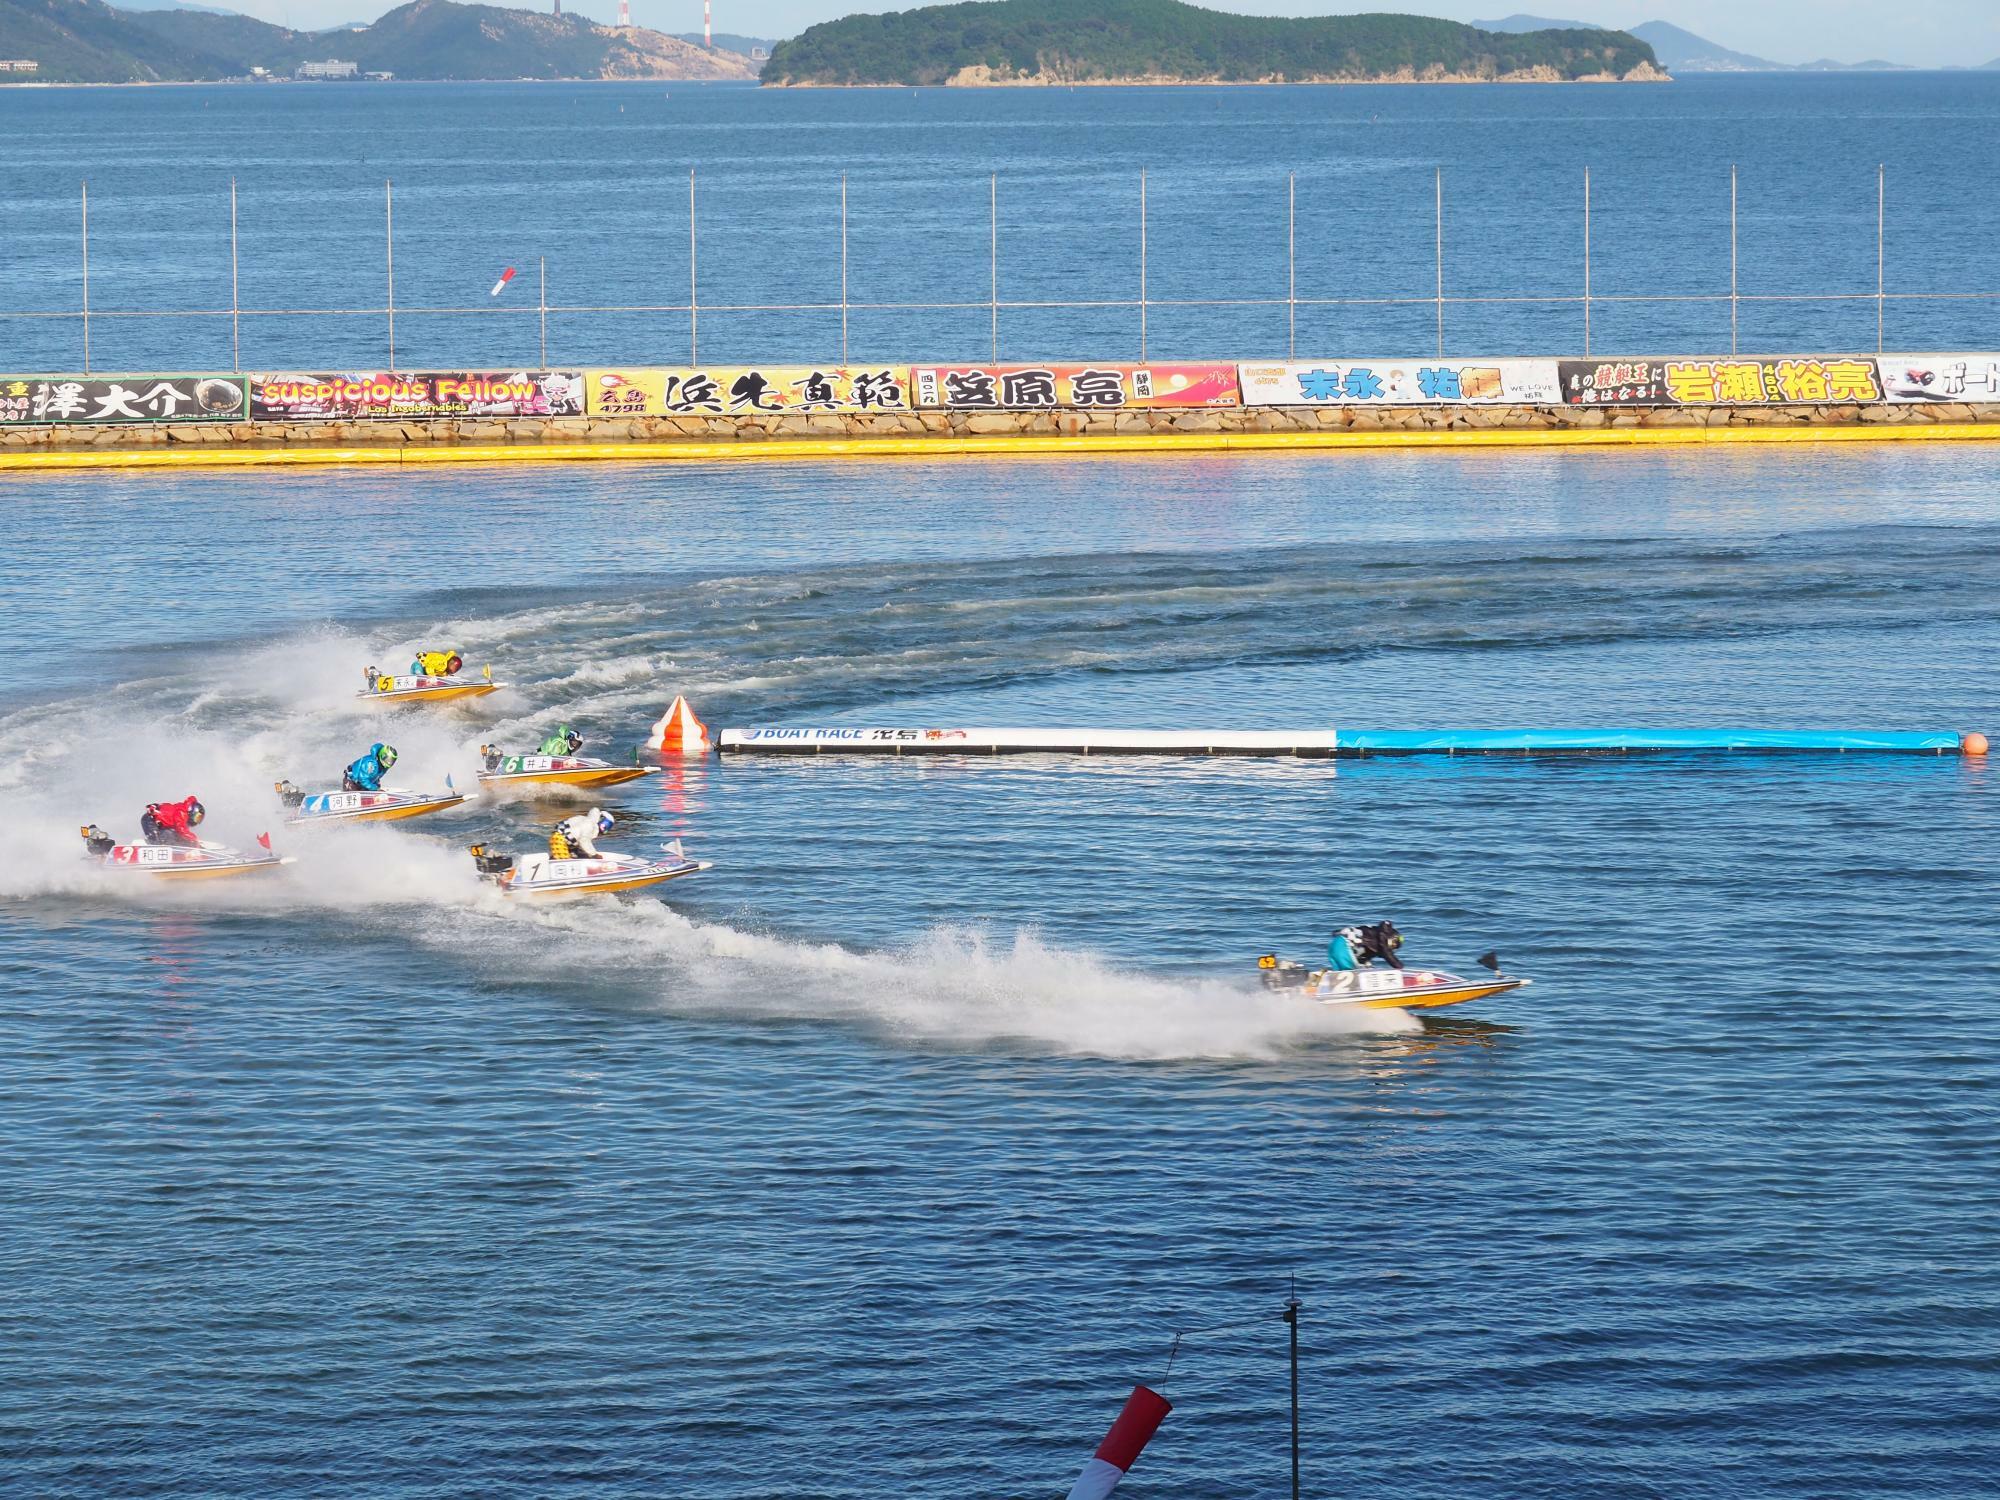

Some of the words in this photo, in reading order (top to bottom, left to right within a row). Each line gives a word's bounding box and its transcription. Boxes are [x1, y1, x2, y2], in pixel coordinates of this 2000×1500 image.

[945, 369, 1125, 405] 笠原亮
[32, 382, 191, 418] 澤大介
[600, 404, 646, 412] 4798
[380, 676, 392, 691] 5
[764, 729, 809, 739] BOAT
[816, 729, 864, 739] RACE
[505, 757, 520, 774] 6
[527, 758, 548, 769] 井上
[116, 846, 134, 864] 3
[143, 849, 169, 861] 和田
[531, 863, 541, 881] 1
[1332, 971, 1355, 993] 2
